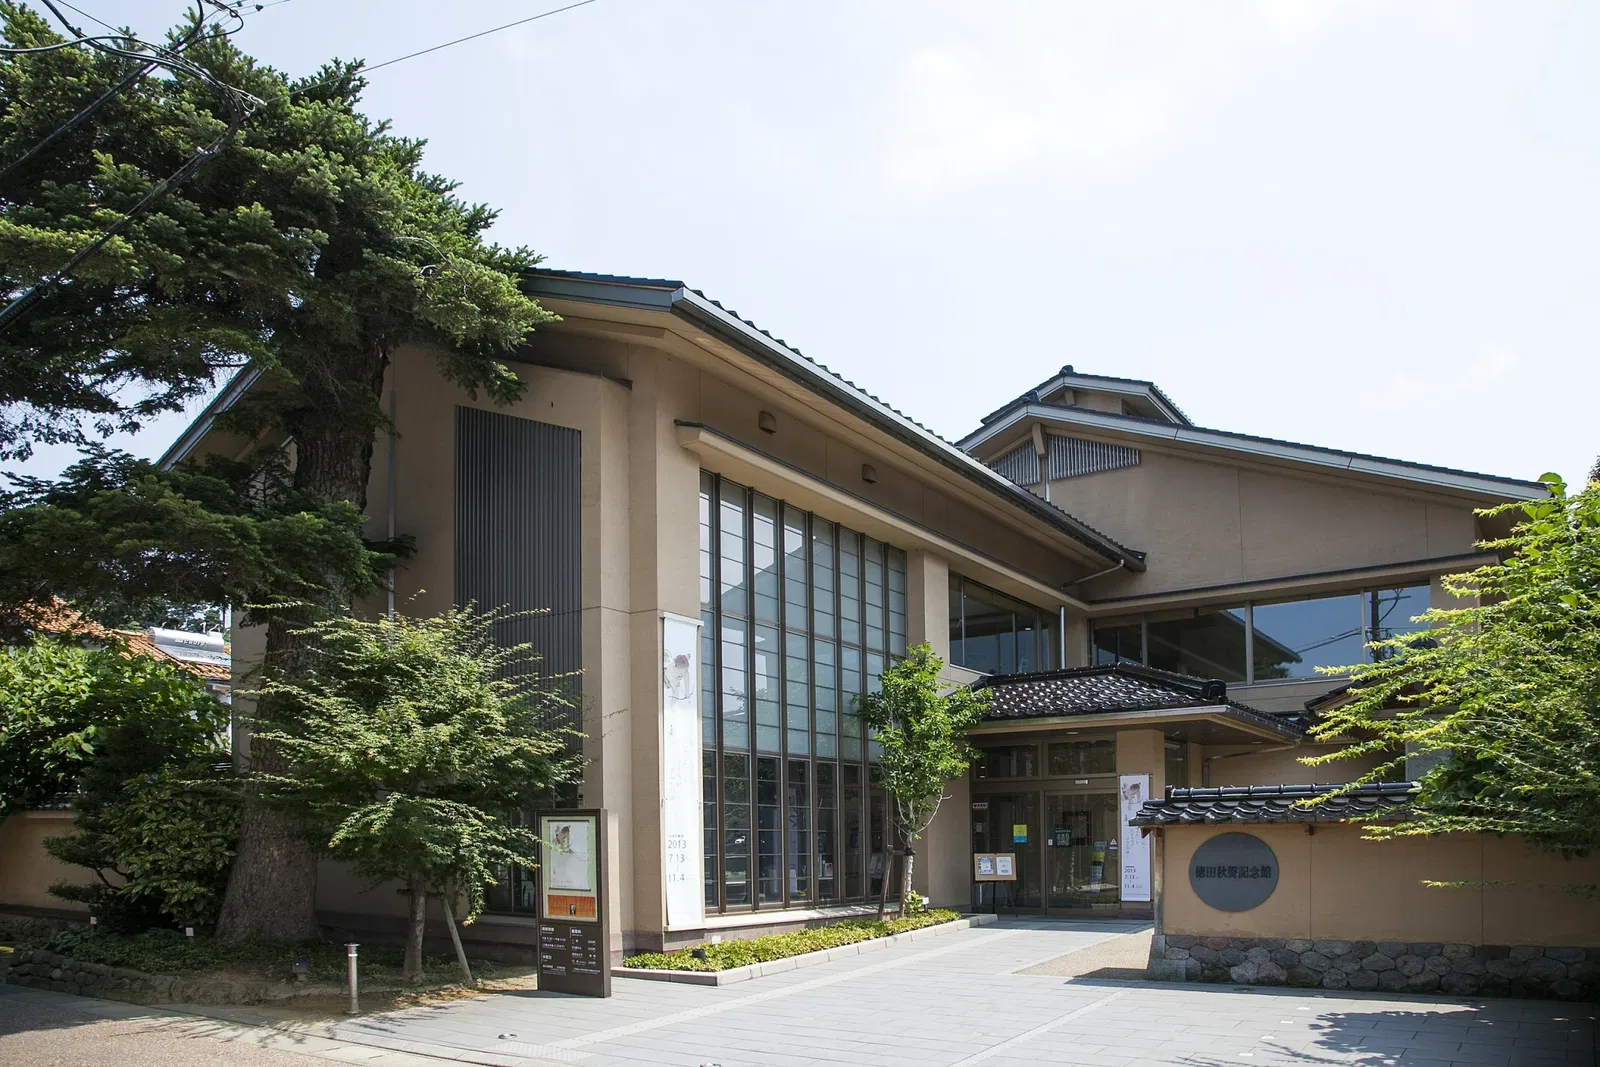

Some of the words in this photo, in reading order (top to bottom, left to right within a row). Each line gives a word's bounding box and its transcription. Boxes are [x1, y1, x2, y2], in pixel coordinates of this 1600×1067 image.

[668, 839, 687, 849] 2013
[668, 853, 685, 863] 7.13
[668, 873, 685, 882] 11.4
